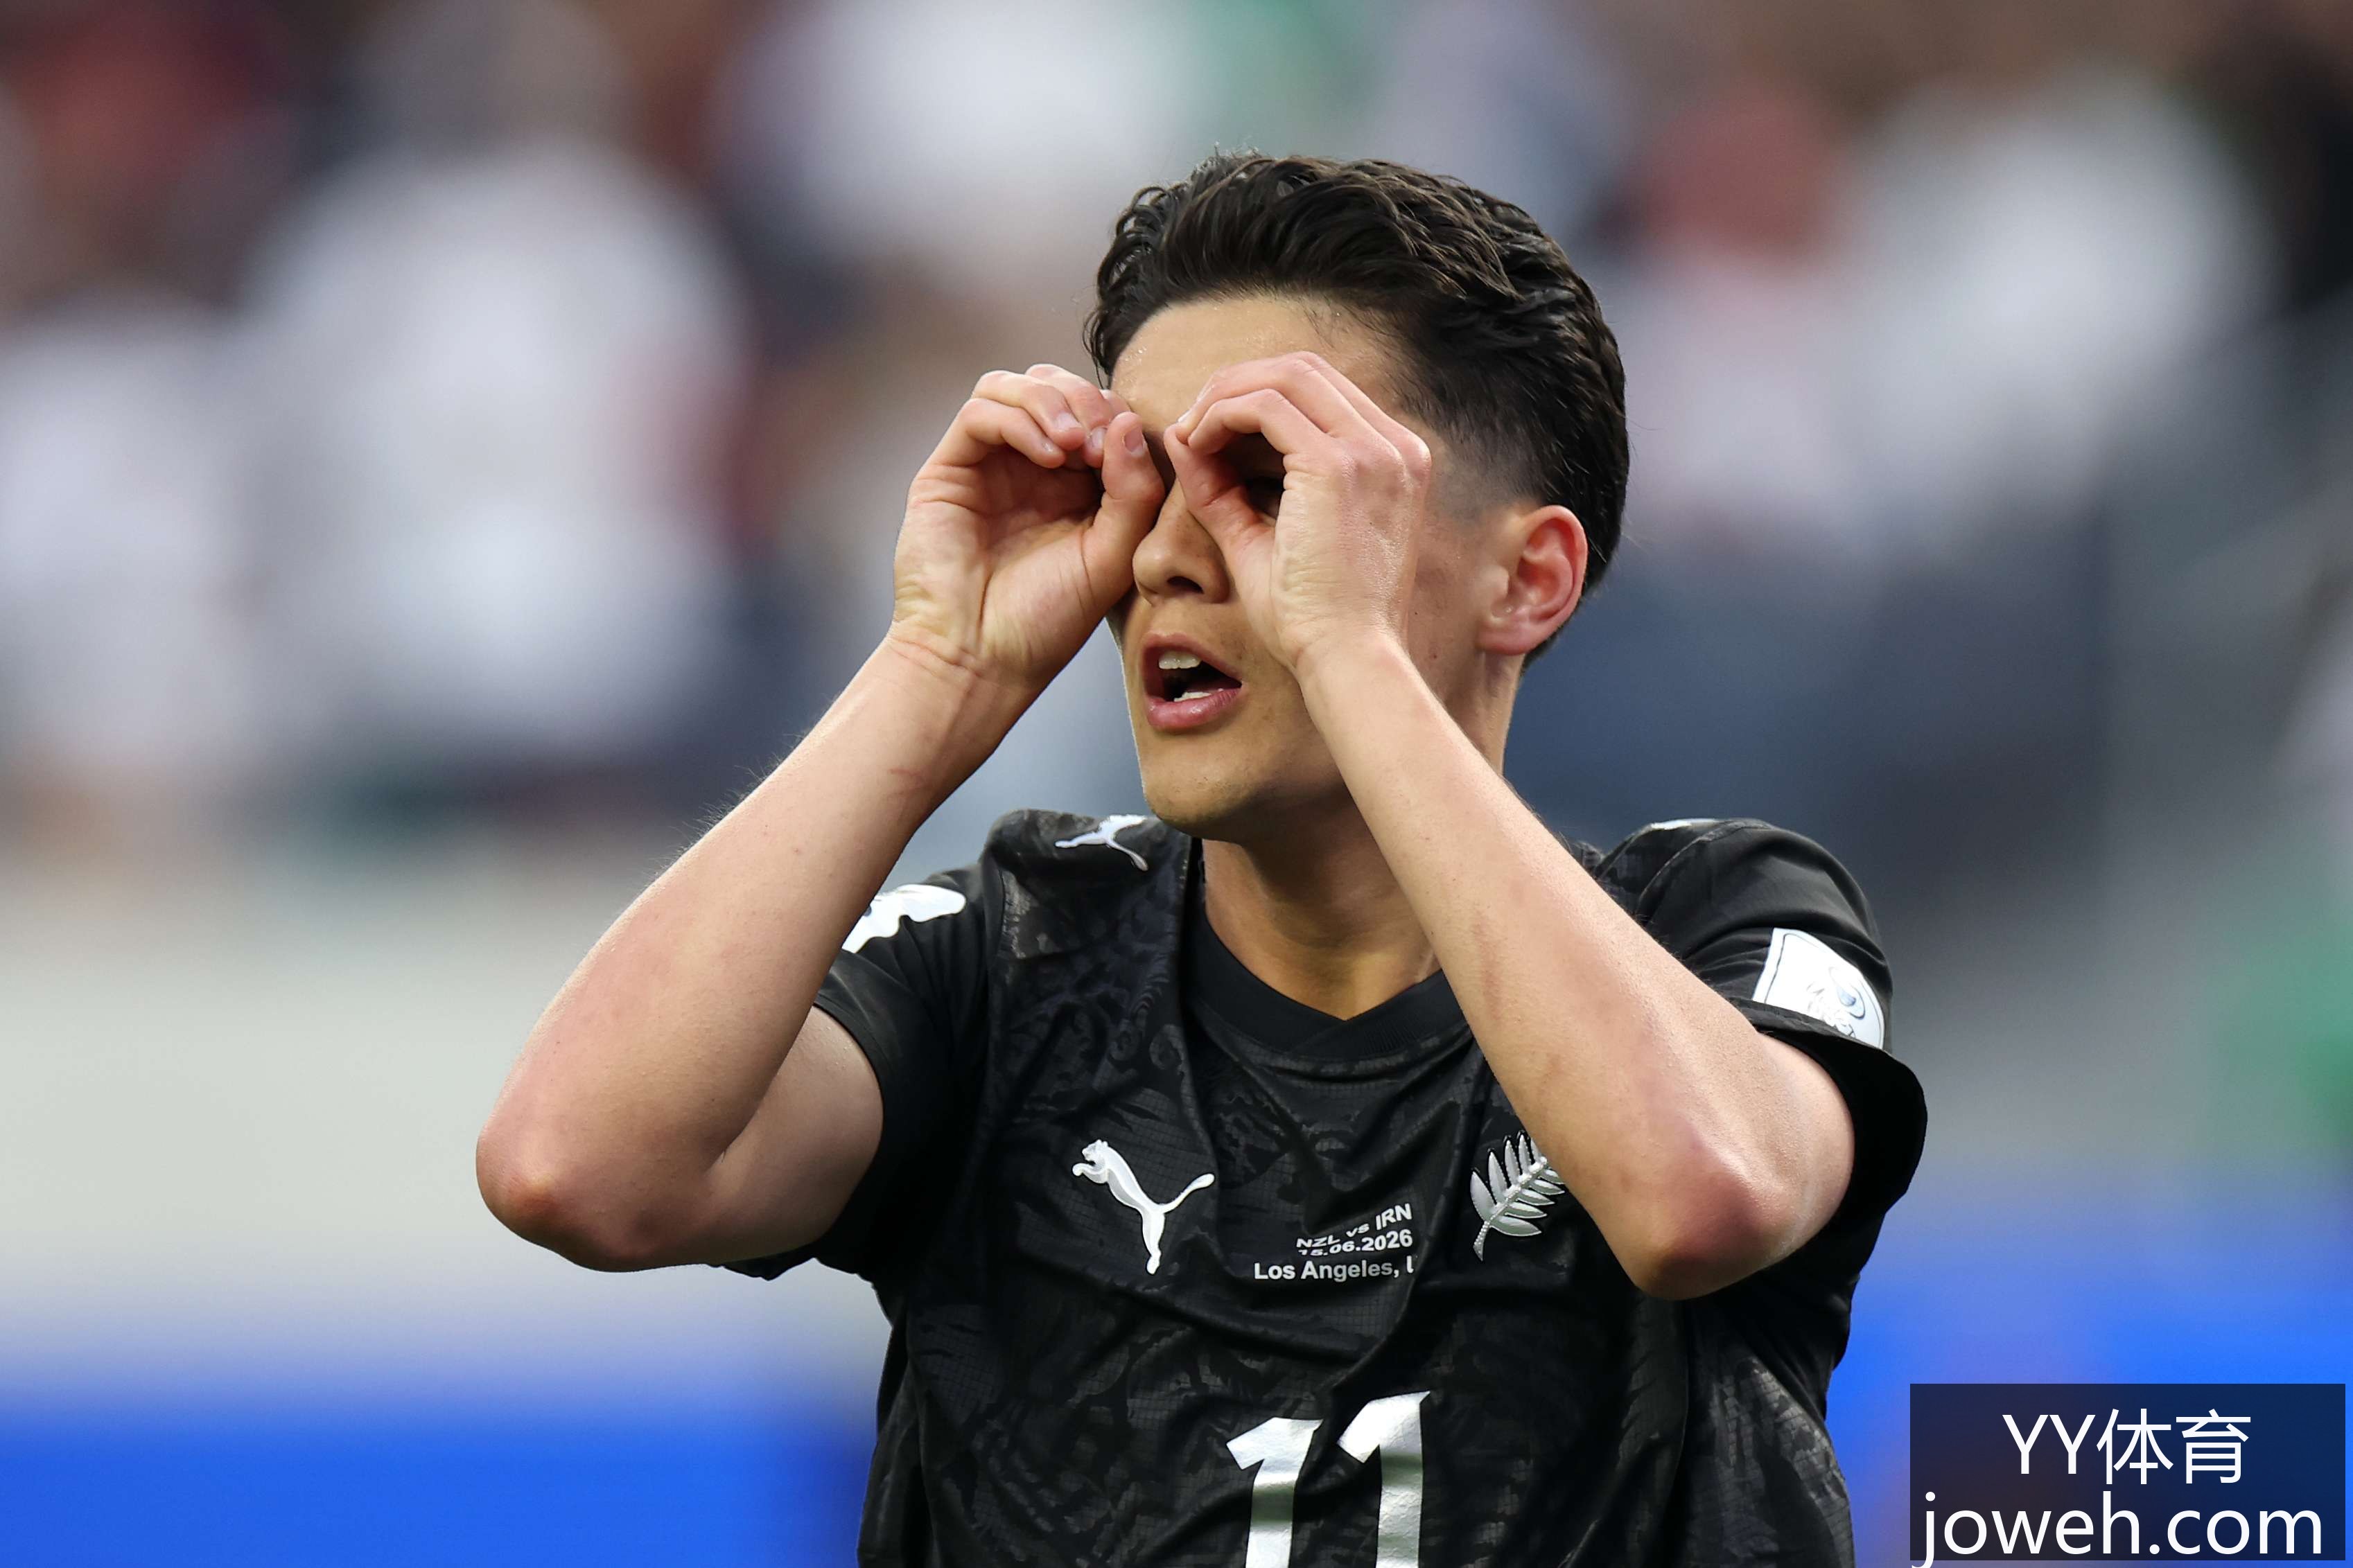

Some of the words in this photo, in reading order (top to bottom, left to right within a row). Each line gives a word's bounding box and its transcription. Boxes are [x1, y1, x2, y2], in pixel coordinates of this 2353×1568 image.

[1296, 1235, 1340, 1248] NZL
[1346, 1223, 1370, 1237] vs
[1375, 1203, 1412, 1231] IRN
[1298, 1228, 1413, 1256] 15.06.2026
[1254, 1262, 1296, 1280] Los
[1300, 1260, 1399, 1283] Angeles,
[1226, 1391, 1431, 1568] 11
